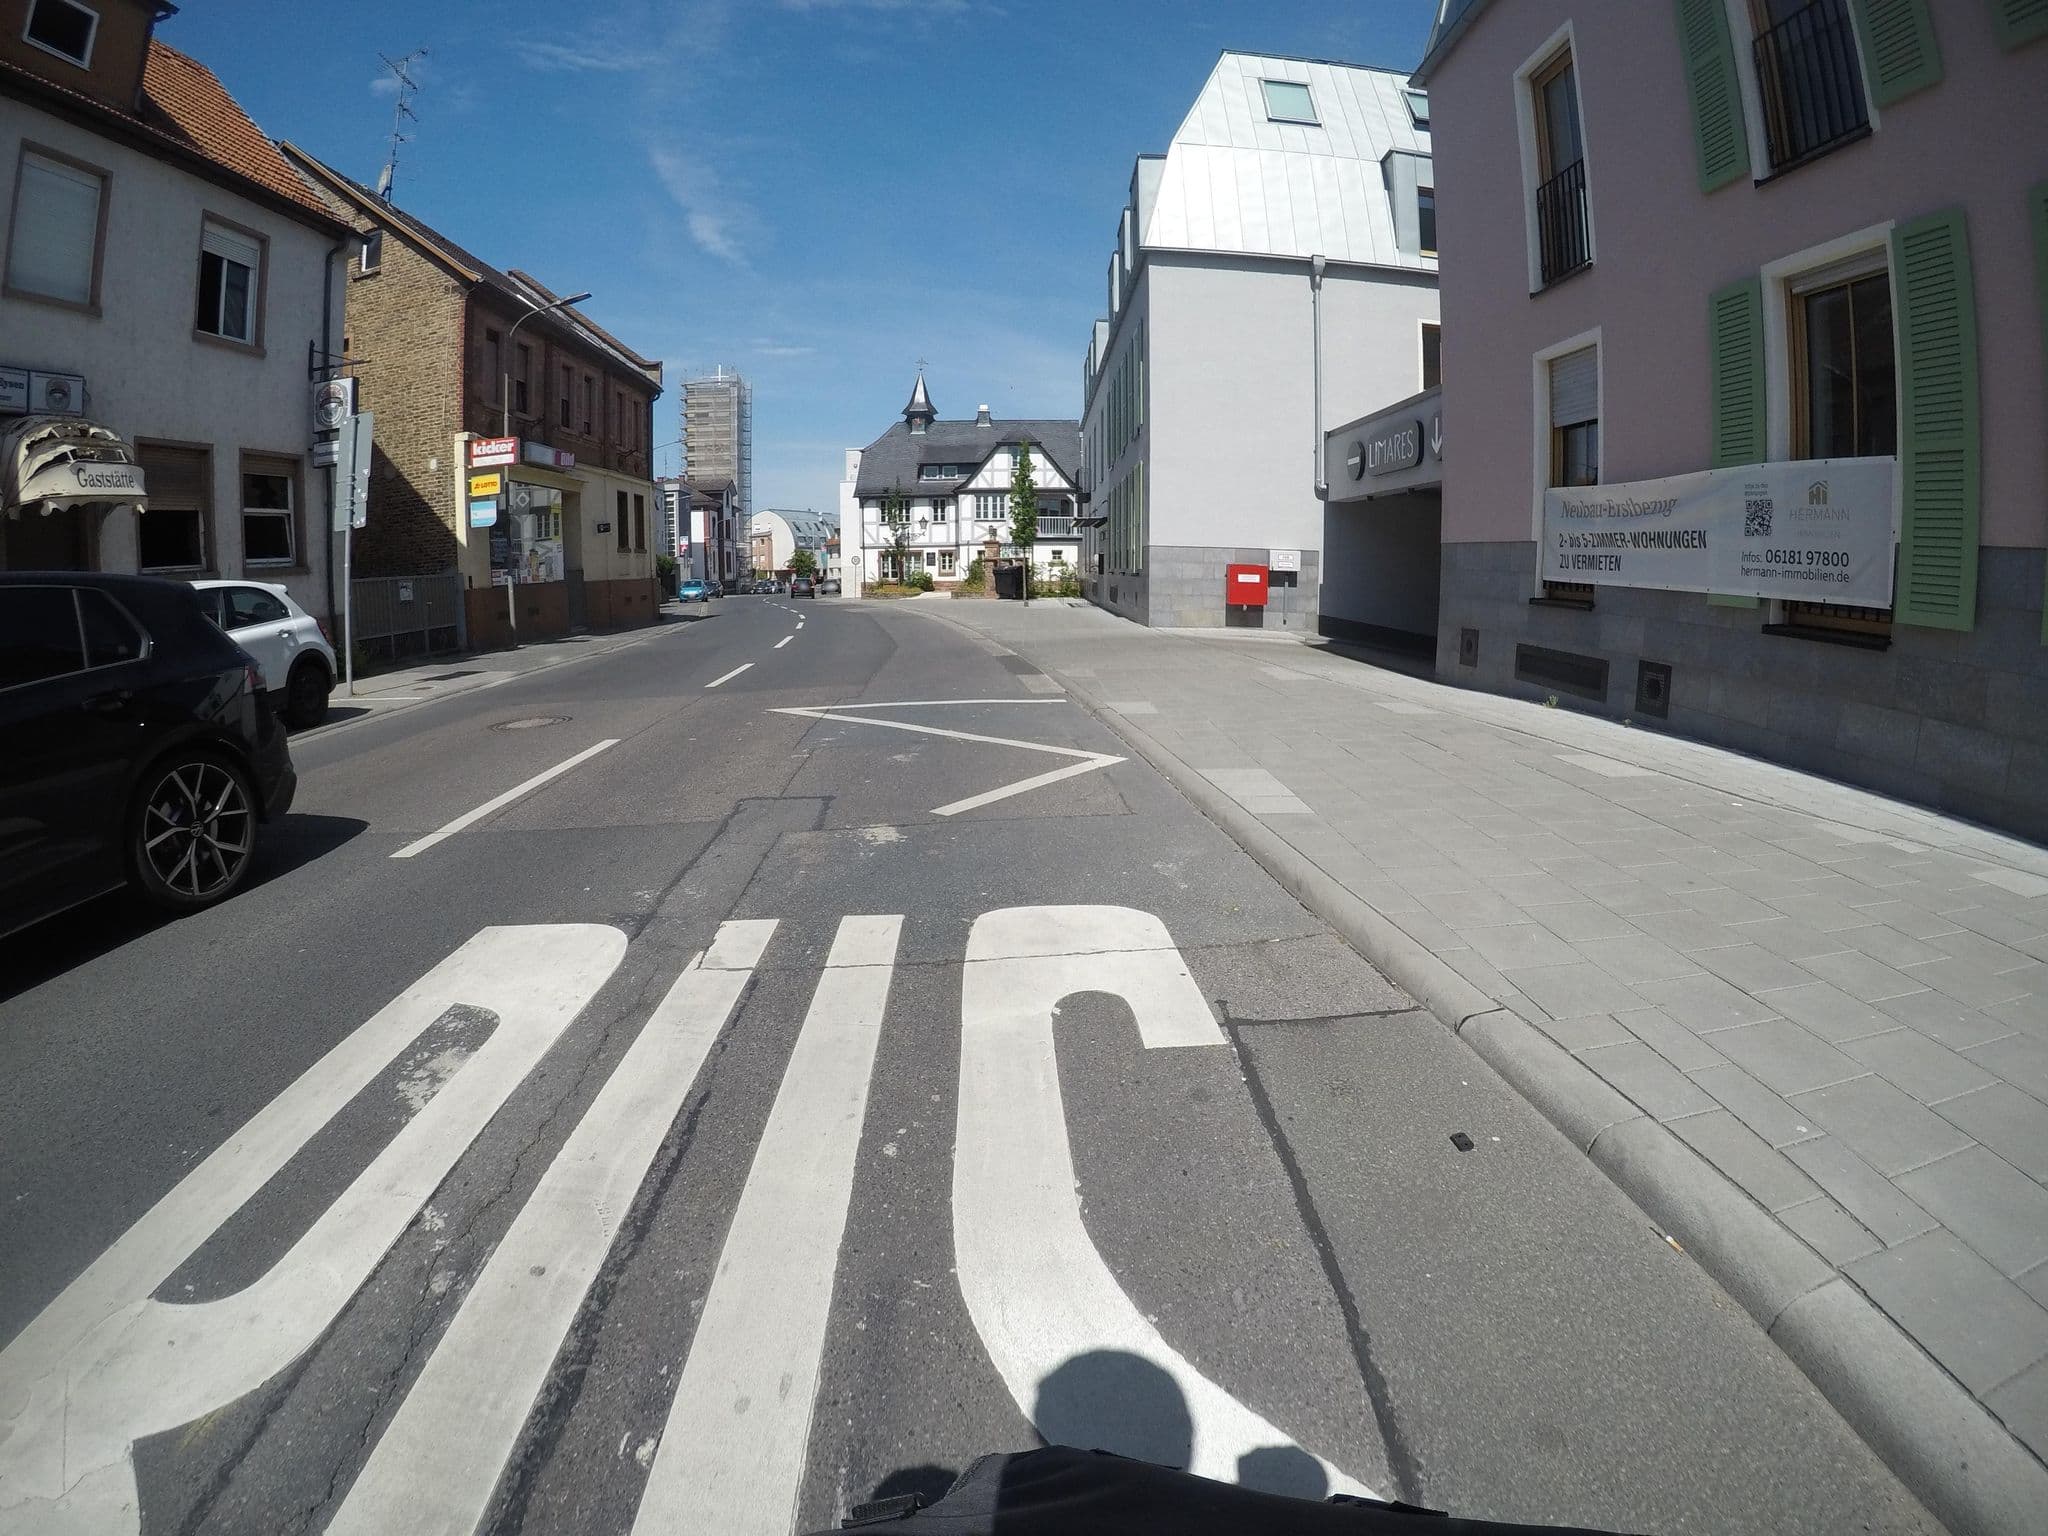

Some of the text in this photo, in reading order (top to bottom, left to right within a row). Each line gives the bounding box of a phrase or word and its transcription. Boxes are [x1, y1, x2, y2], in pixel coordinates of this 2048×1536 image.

[473, 440, 515, 456] kicker
[1369, 429, 1414, 468] LIMARES
[77, 467, 135, 488] Gaststätte
[1560, 498, 1678, 519] Neubau-Erstbezug
[1789, 508, 1850, 521] HERMANN
[1559, 530, 1708, 549] 2- bis 5-ZIMMER-WOHNUNGEN
[1559, 554, 1622, 571] ZU VERMIETEN
[1765, 549, 1803, 565] 06181
[1806, 550, 1850, 567] 97800
[1741, 565, 1850, 583] hermann-immobilien.de
